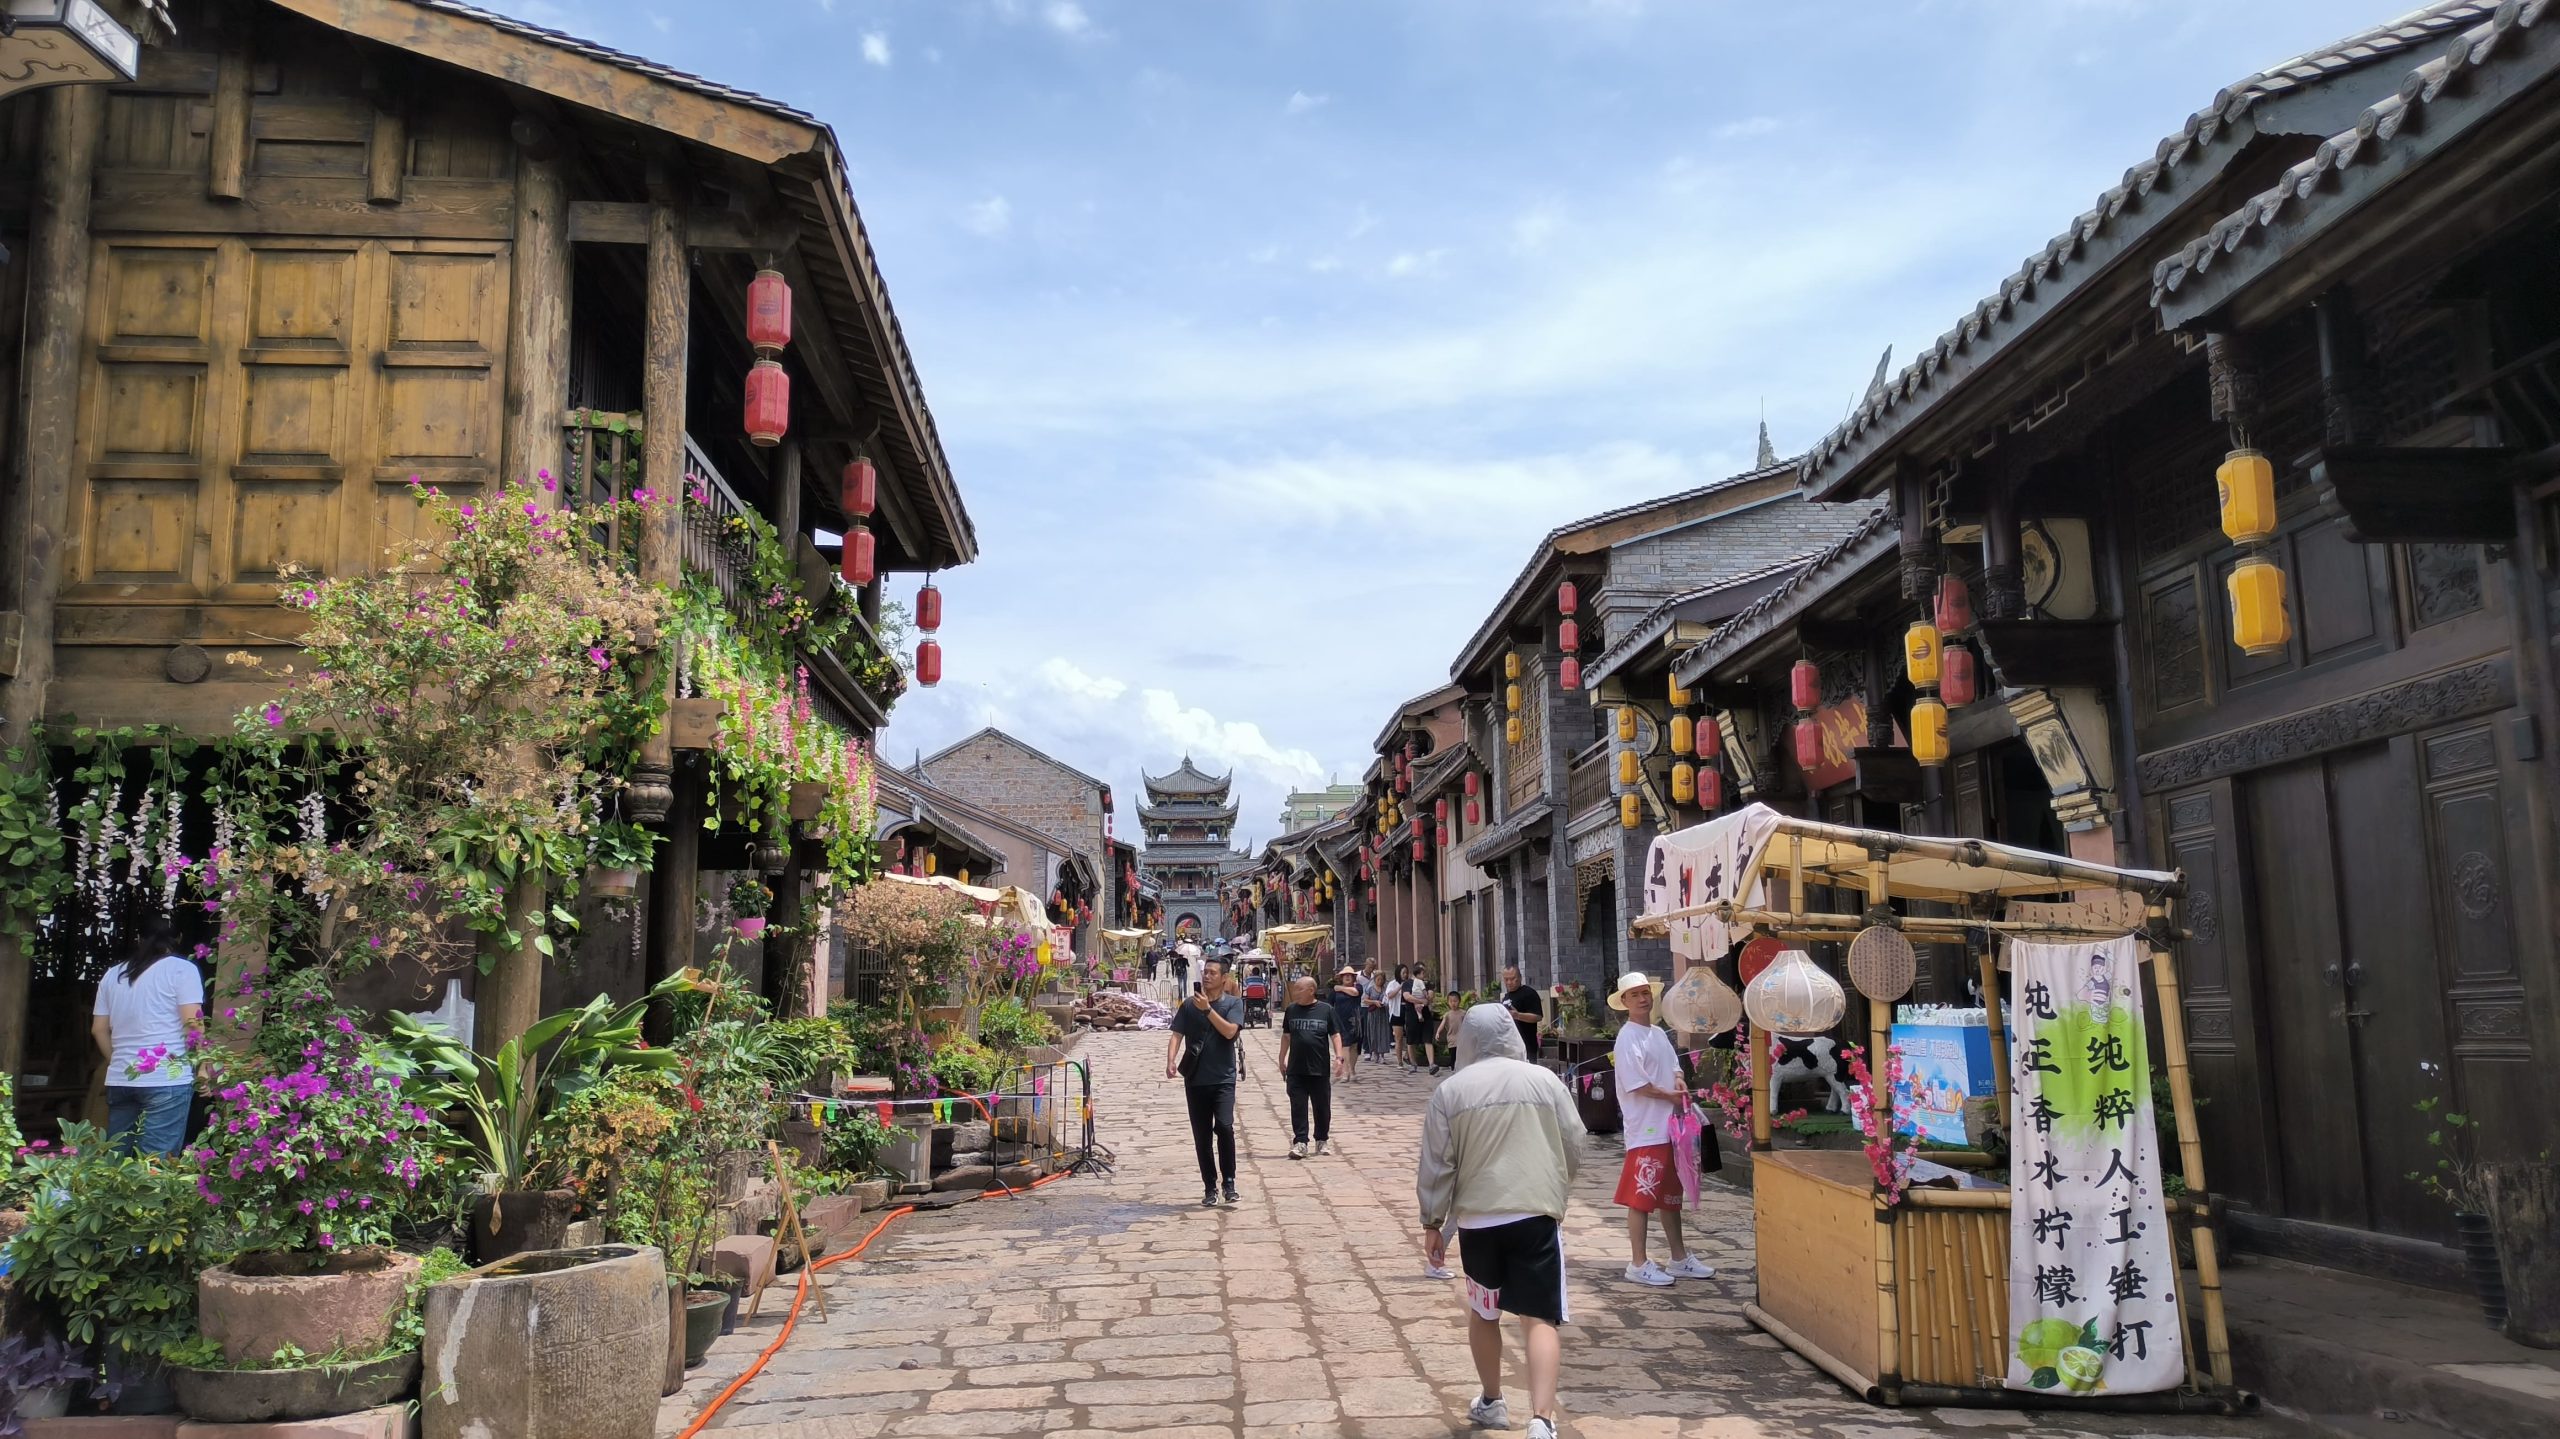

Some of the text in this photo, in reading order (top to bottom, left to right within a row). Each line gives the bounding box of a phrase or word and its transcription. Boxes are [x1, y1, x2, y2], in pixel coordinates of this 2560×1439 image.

[2024, 979, 2080, 1309] 纯正香水柠檬
[2086, 1034, 2153, 1362] 纯粹人工锤打
